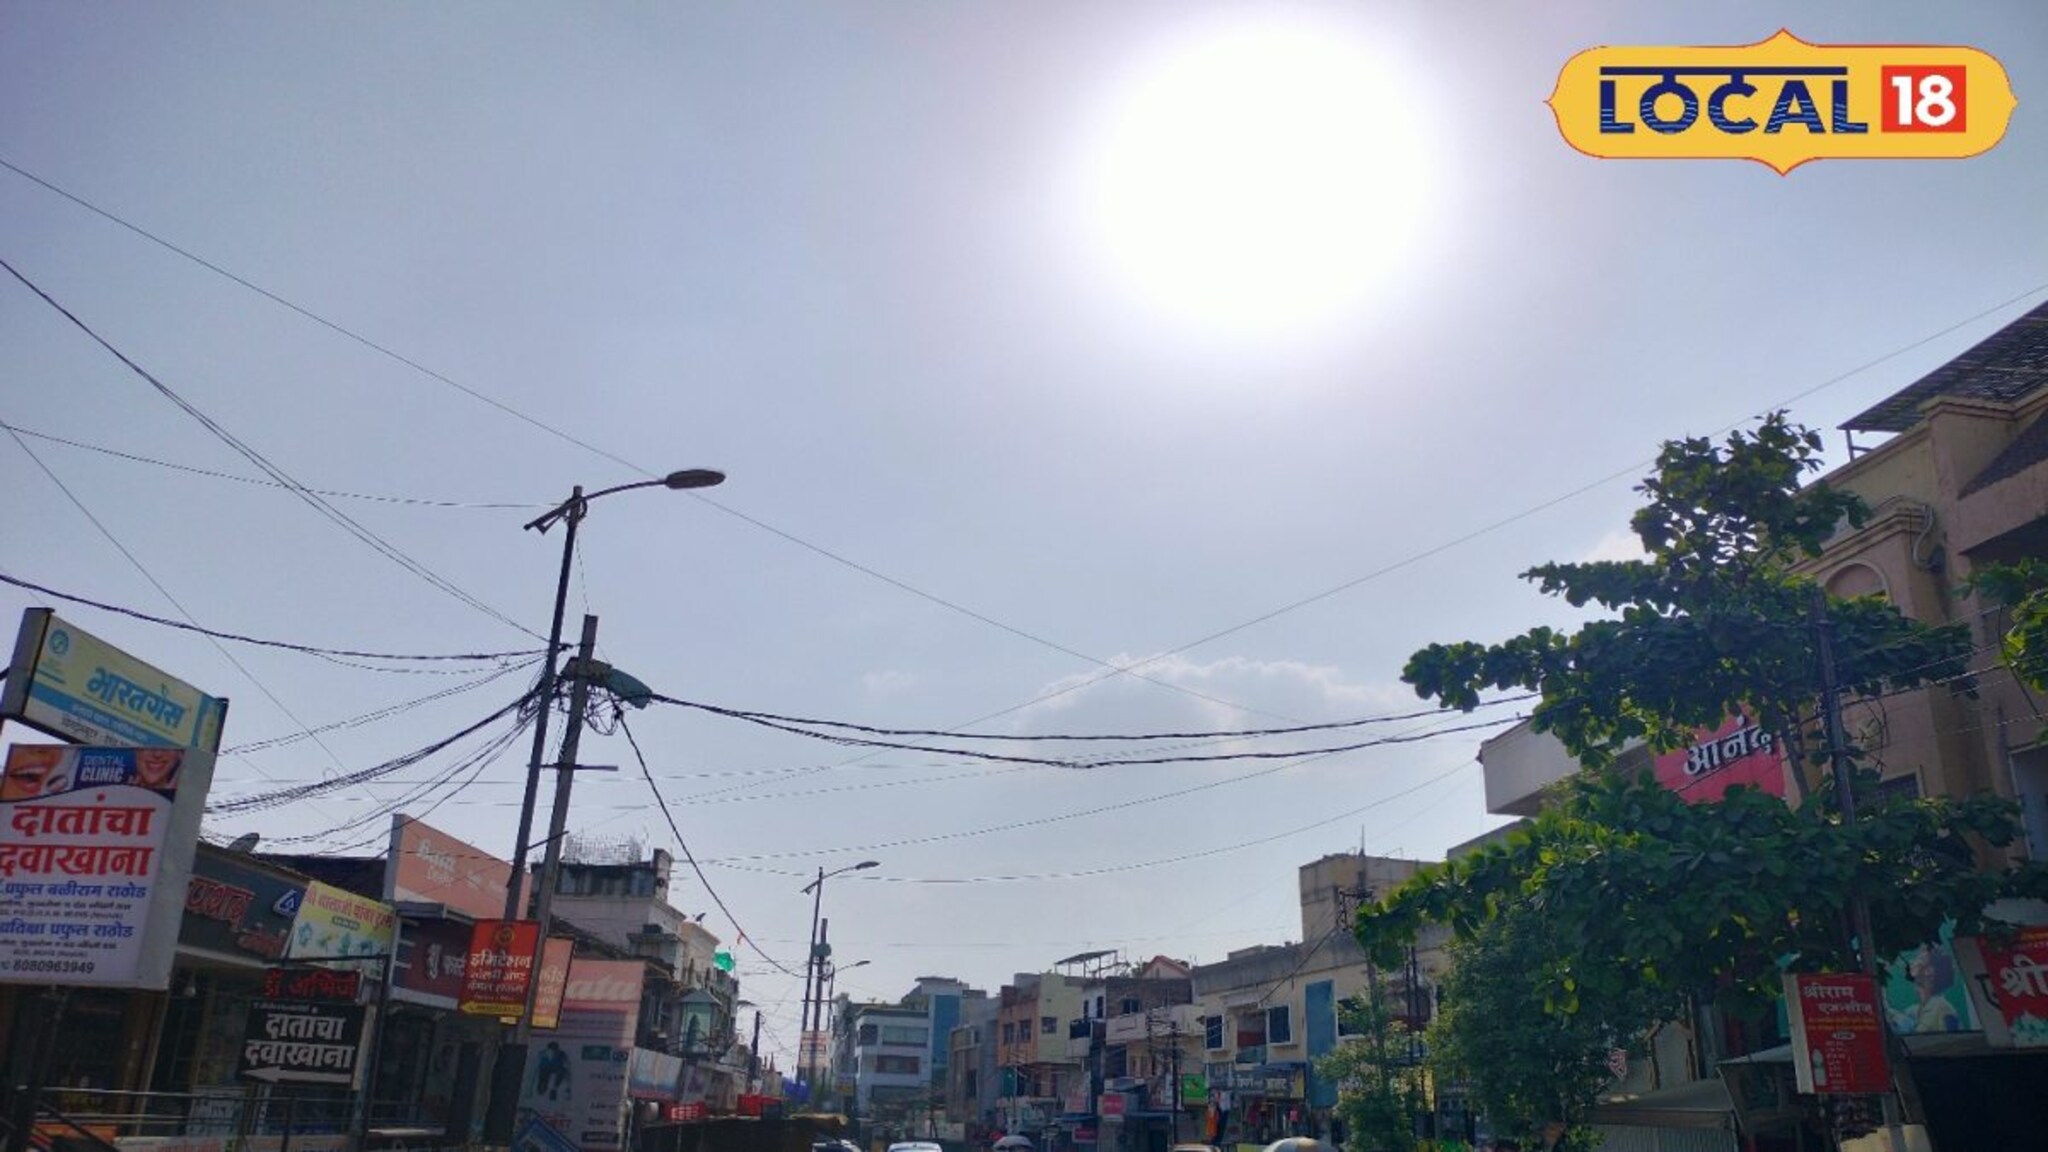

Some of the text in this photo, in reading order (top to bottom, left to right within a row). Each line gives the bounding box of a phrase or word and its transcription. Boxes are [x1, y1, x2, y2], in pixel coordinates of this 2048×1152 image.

[82, 754, 125, 767] DENTAL
[80, 767, 125, 782] CLINIC
[12, 793, 156, 837] दातांचा
[0, 843, 154, 877] दवाखाना
[107, 881, 147, 899] राठोड
[94, 922, 134, 938] राठोड
[1803, 981, 1855, 999] श्रीराम
[266, 1006, 346, 1041] दातांचा
[245, 1039, 356, 1069] दवाखाना
